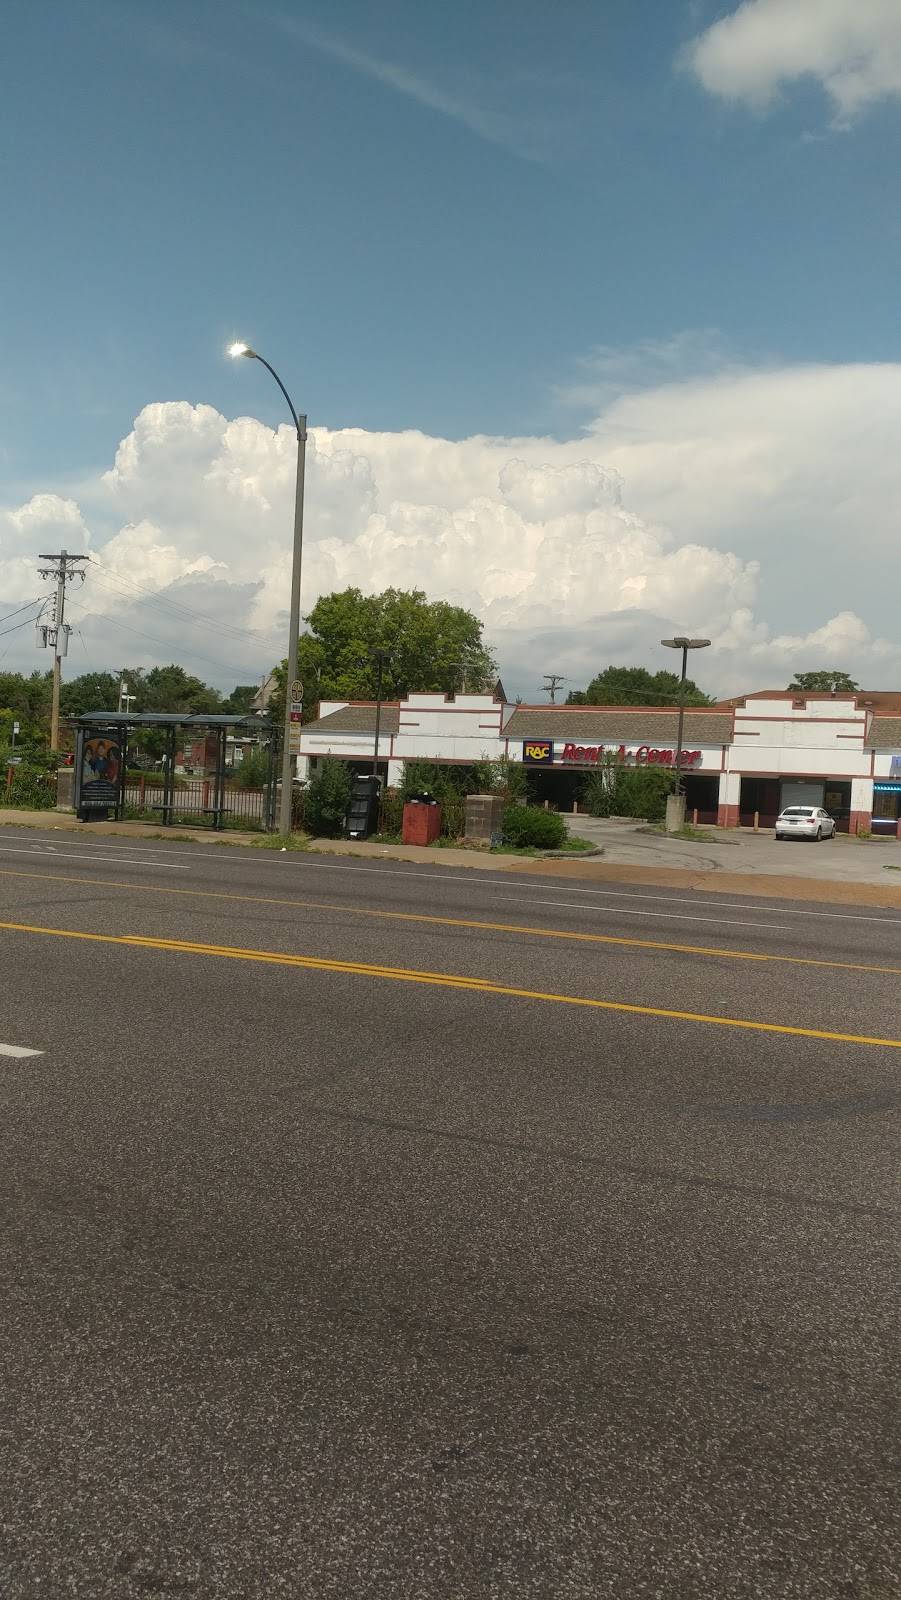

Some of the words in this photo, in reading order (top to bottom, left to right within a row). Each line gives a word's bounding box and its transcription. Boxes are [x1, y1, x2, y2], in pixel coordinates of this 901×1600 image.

[525, 746, 550, 760] RAC
[560, 743, 605, 761] Rent
[636, 746, 702, 765] Cener
